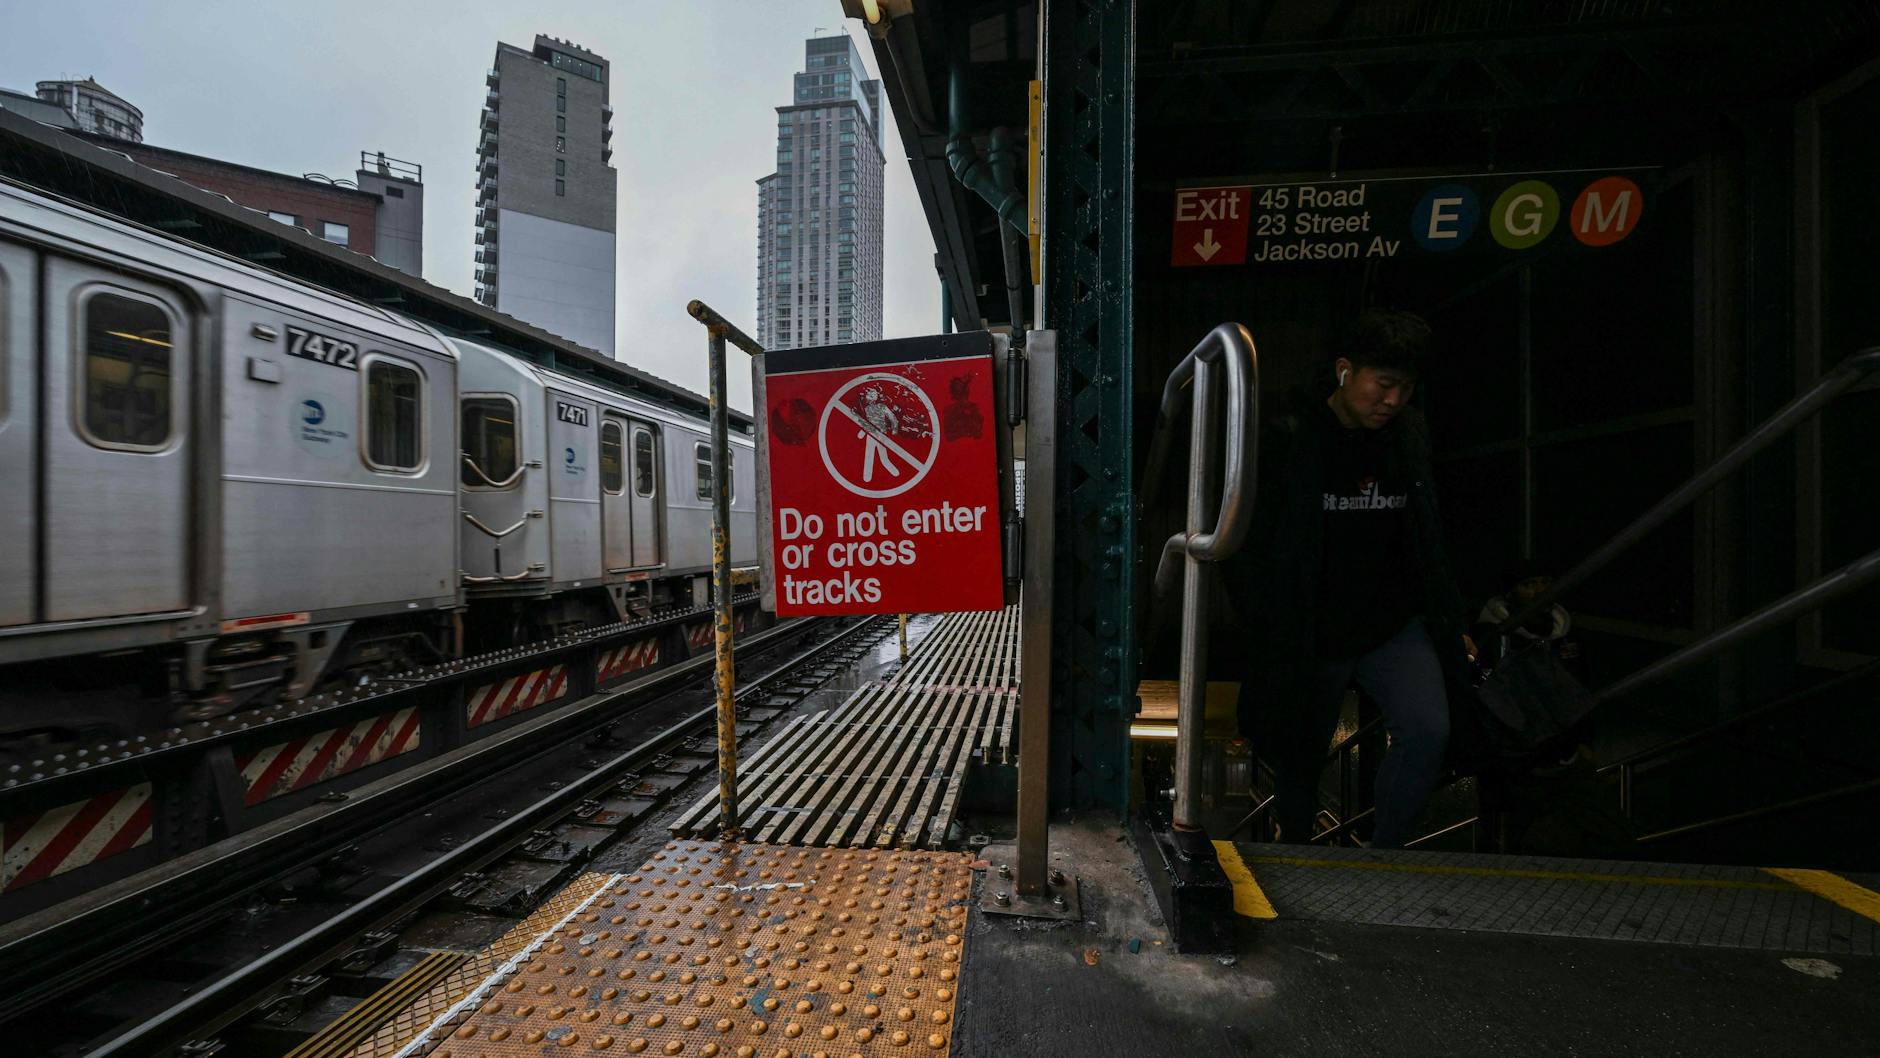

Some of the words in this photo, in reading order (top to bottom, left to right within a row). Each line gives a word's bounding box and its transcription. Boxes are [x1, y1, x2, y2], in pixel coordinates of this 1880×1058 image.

[1176, 190, 1240, 221] Exit
[1259, 188, 1289, 210] 45
[1297, 184, 1365, 208] Road
[1256, 214, 1287, 236] 23
[1294, 211, 1370, 235] Street
[1428, 197, 1463, 239] E
[1504, 193, 1544, 236] G
[1581, 190, 1632, 233] M
[1254, 239, 1359, 262] Jackson
[1366, 236, 1400, 257] Av
[289, 329, 356, 369] 7472
[560, 404, 586, 425] 7471
[779, 507, 824, 540] Do
[837, 505, 889, 537] not
[902, 501, 986, 535] enter
[782, 544, 814, 569] or
[827, 540, 916, 568] cross
[784, 571, 881, 605] tracks
